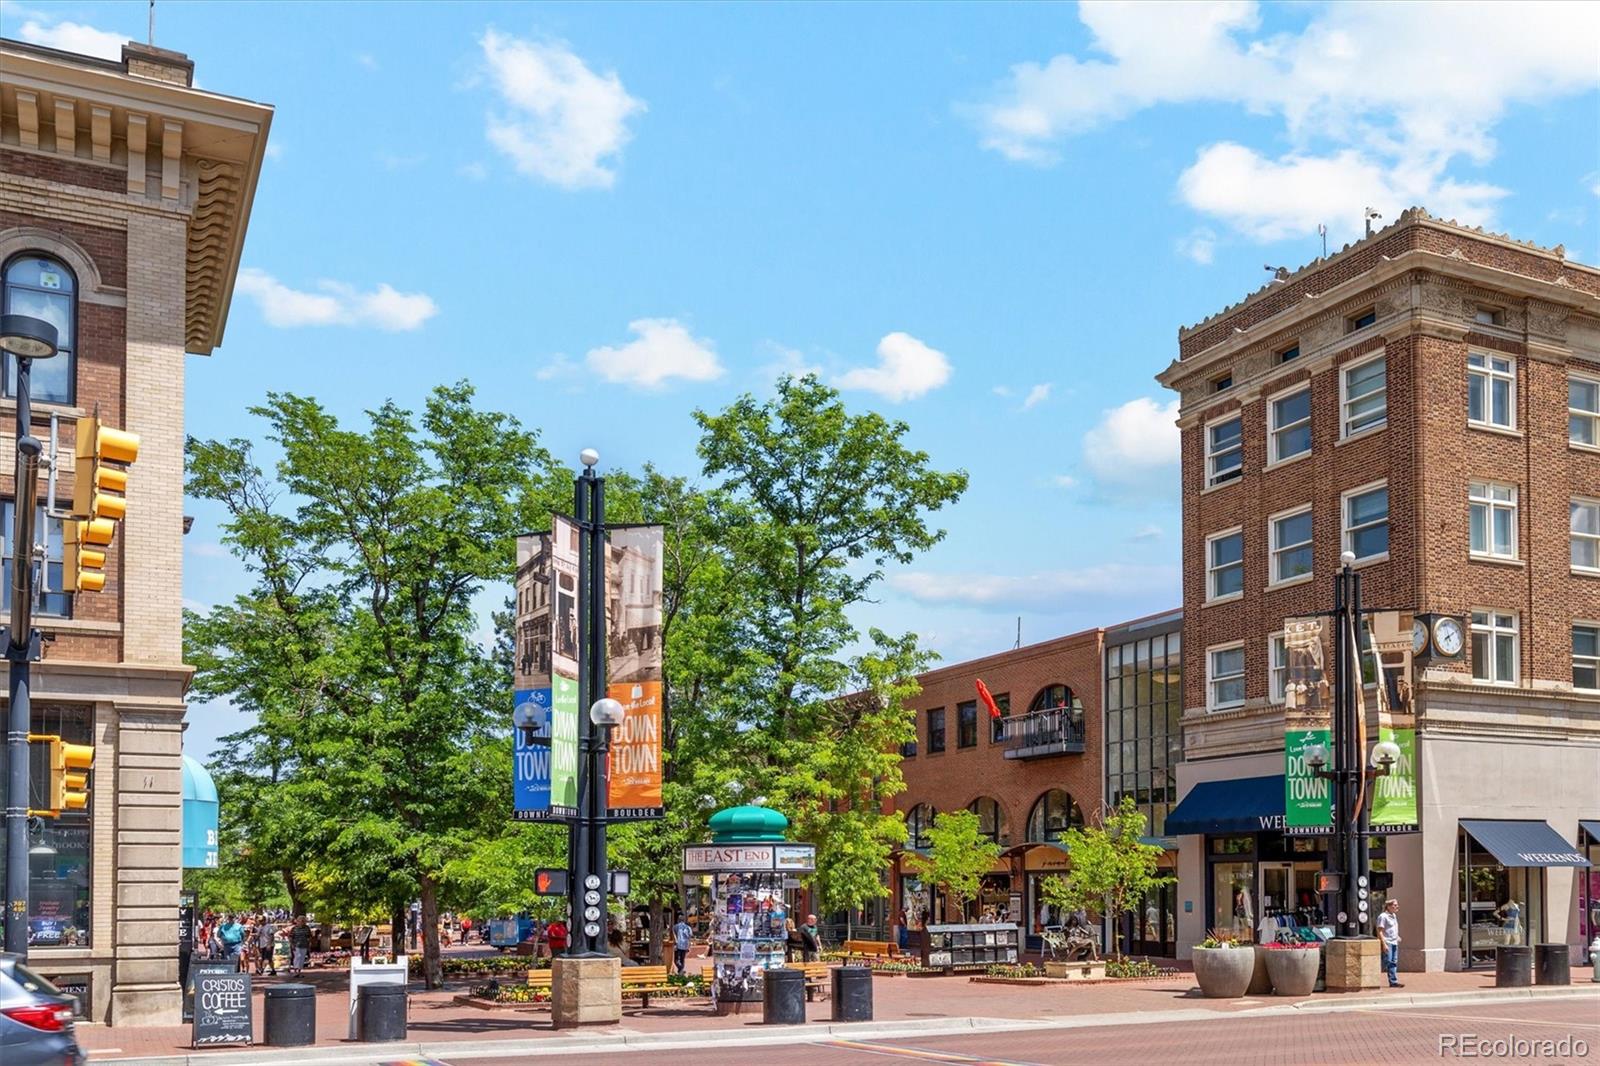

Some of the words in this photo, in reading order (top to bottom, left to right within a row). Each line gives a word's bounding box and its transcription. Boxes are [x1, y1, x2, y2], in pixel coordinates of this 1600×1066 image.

[612, 743, 658, 775] TOWN
[1288, 777, 1328, 800] TOWN
[1377, 776, 1413, 798] TOWN
[614, 808, 656, 817] BOULDER
[1289, 826, 1331, 834] DOWNTOWN
[688, 852, 703, 862] THE
[704, 849, 743, 863] EAST
[744, 851, 770, 860] END
[1517, 852, 1587, 863] WEEKENDS
[37, 930, 60, 939] FREE
[202, 979, 245, 991] CRISTOS
[202, 992, 247, 1010] COFFEE
